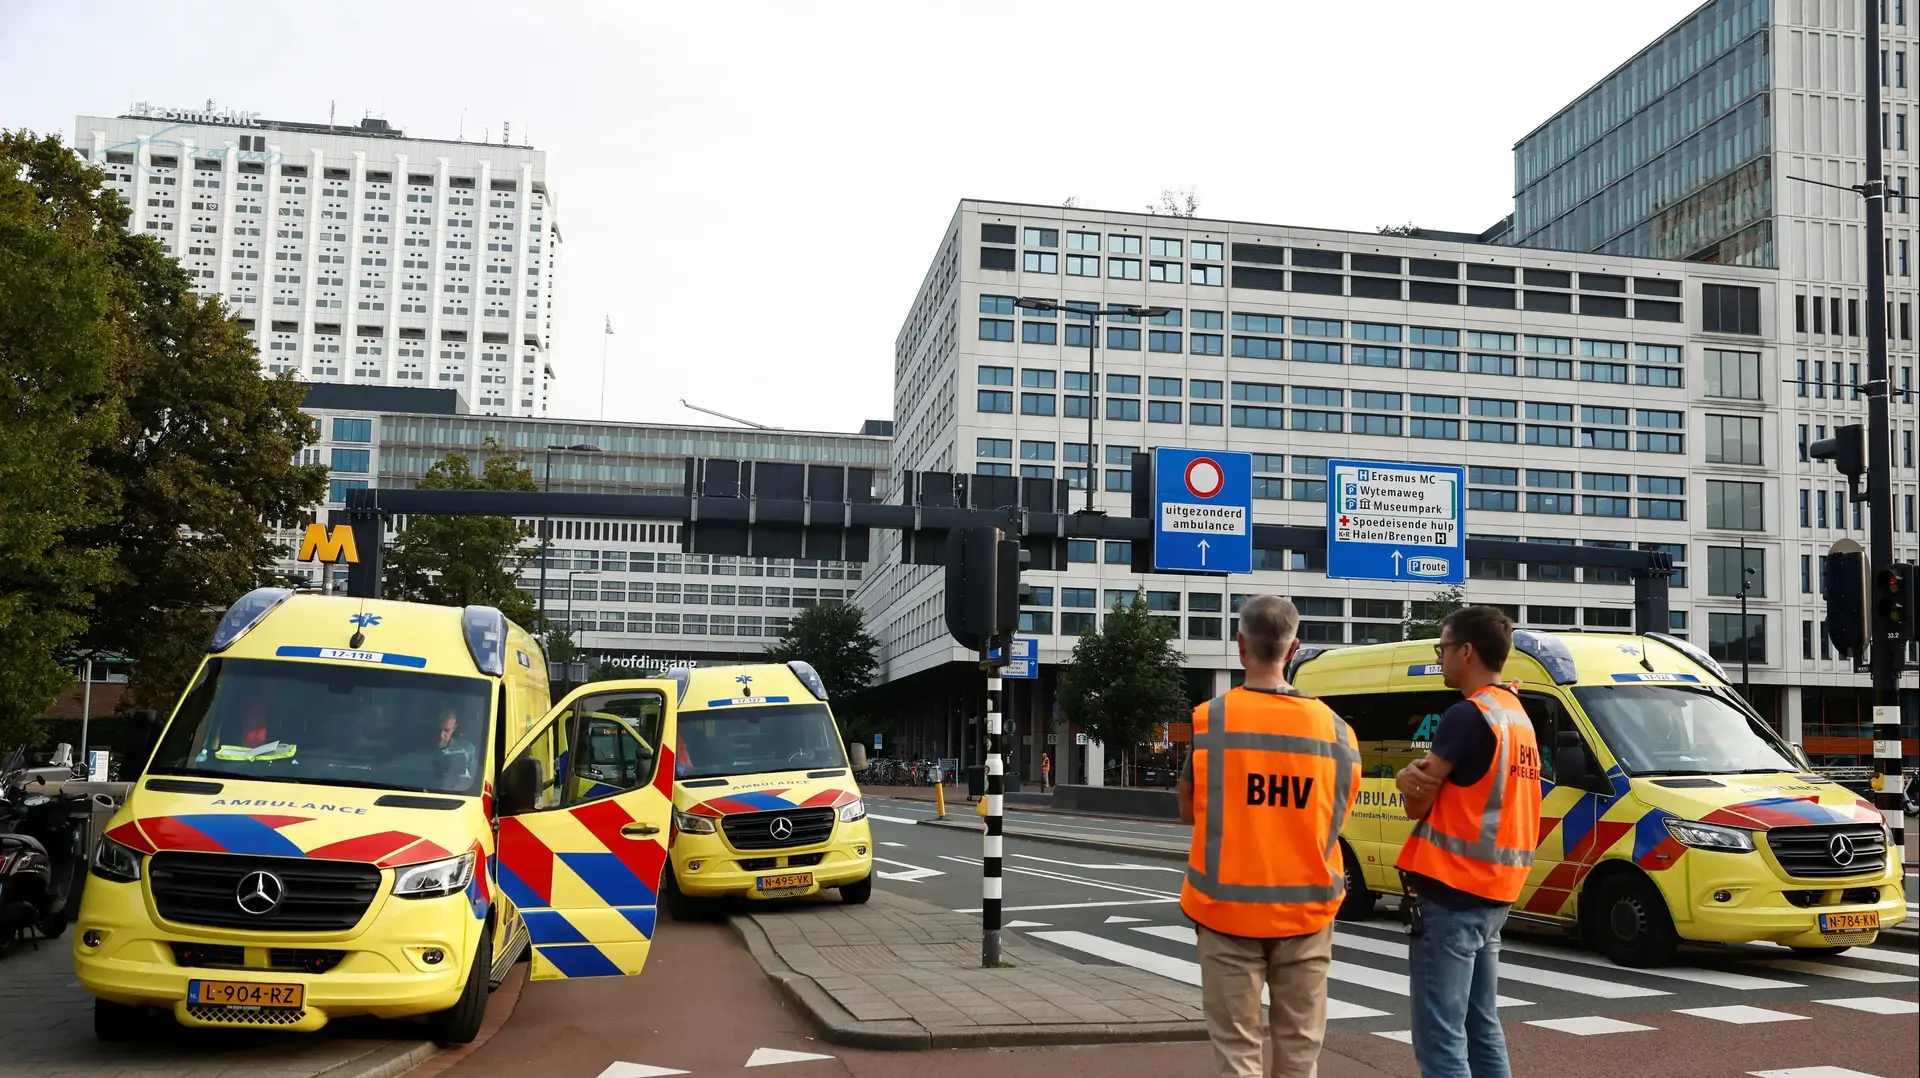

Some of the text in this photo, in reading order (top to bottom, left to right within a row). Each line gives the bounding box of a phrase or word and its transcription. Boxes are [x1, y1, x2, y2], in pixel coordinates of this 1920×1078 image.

[1372, 472, 1416, 483] Erasmus
[1419, 475, 1436, 484] MC
[1360, 486, 1424, 500] Wytemaweg
[1166, 506, 1242, 518] uitgezonderd
[1374, 501, 1442, 514] Museumpark
[1173, 520, 1235, 531] ambulance
[1353, 517, 1454, 532] Spoedeisende hulp
[298, 524, 359, 564] M
[1353, 530, 1433, 544] Halen/Brengen
[1422, 562, 1446, 571] route
[331, 650, 373, 660] 17-118
[600, 654, 697, 672] Hoofdingang
[732, 781, 810, 790] AMBULANCE
[1247, 773, 1314, 809] BHV
[210, 799, 368, 815] AMBULANCE
[765, 875, 809, 887] N-495-VK
[1829, 914, 1876, 928] N-784-KN
[206, 984, 295, 1003] L-904-RZ
